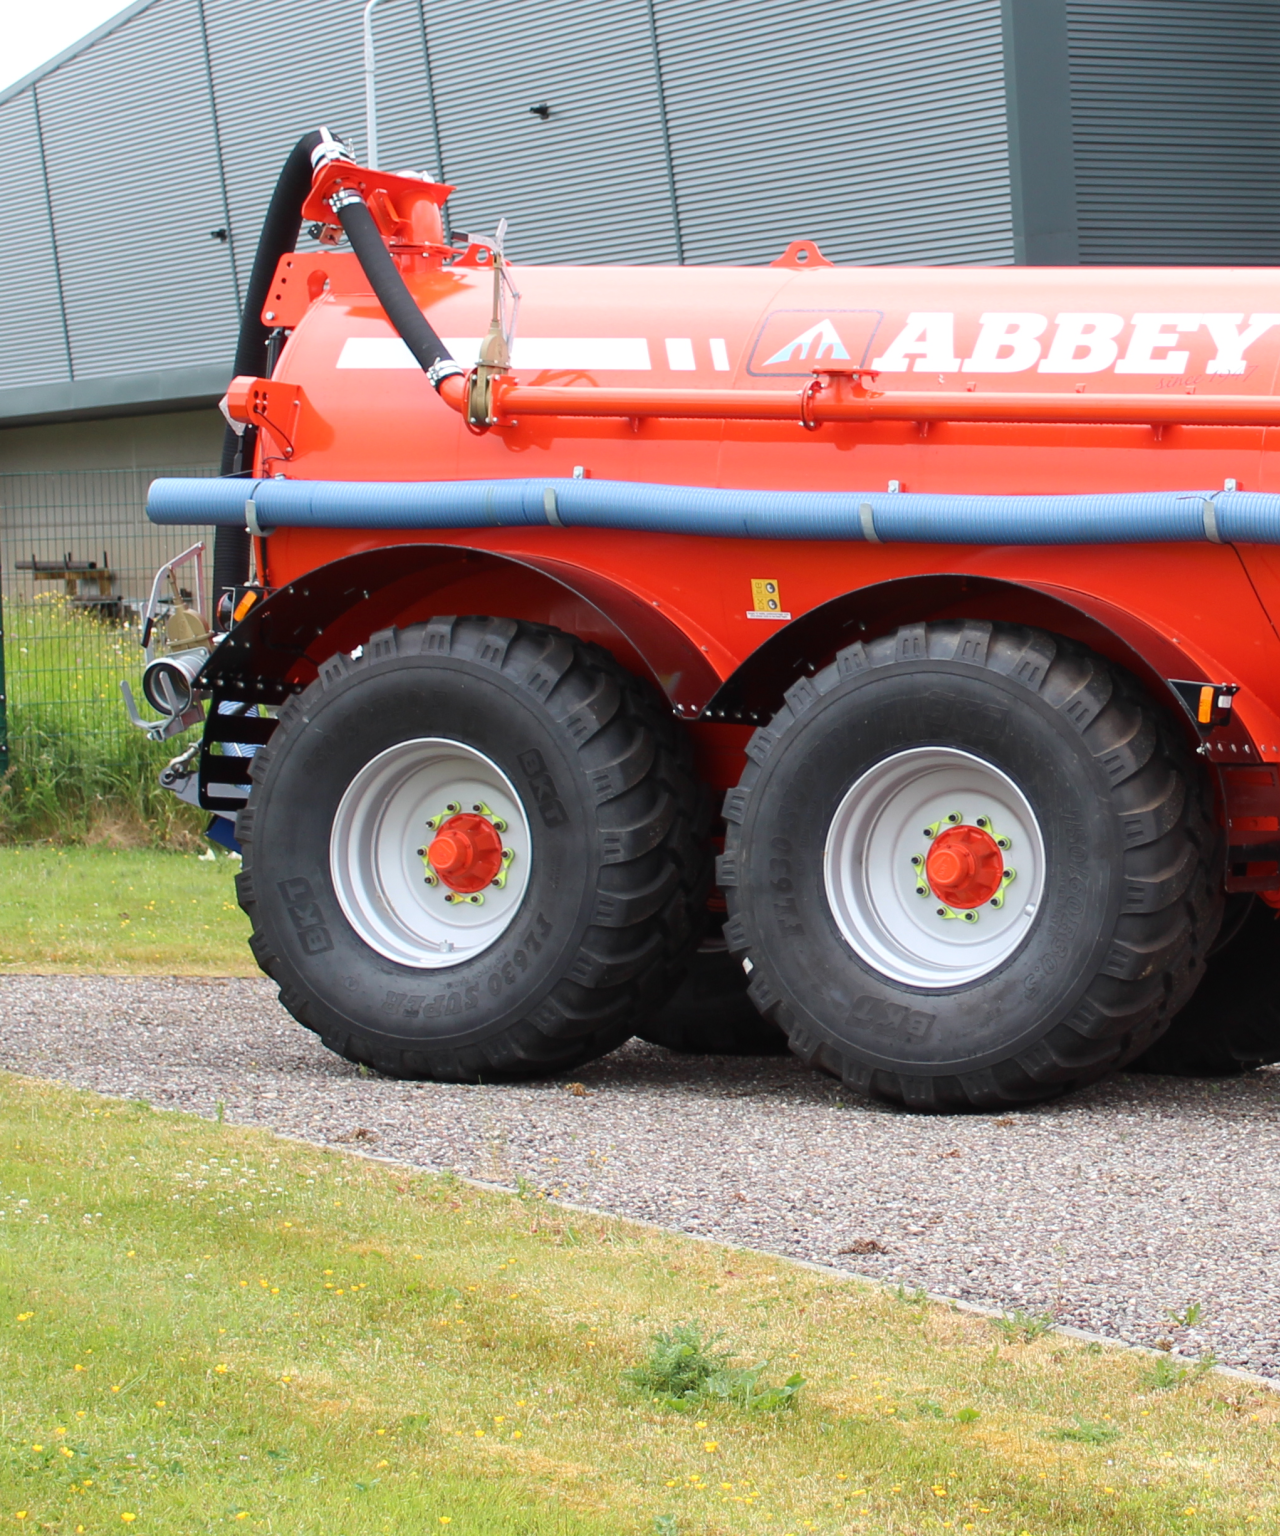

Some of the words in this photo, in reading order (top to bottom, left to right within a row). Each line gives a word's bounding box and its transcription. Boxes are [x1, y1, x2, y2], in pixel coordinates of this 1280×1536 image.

[1155, 374, 1202, 390] since
[1209, 364, 1259, 383] 1947
[924, 689, 1008, 739] BKT
[518, 747, 569, 828] BKT
[277, 876, 333, 956] BKT
[490, 913, 557, 998] FL630
[380, 988, 483, 1021] SUPER
[844, 994, 937, 1044] BKT
